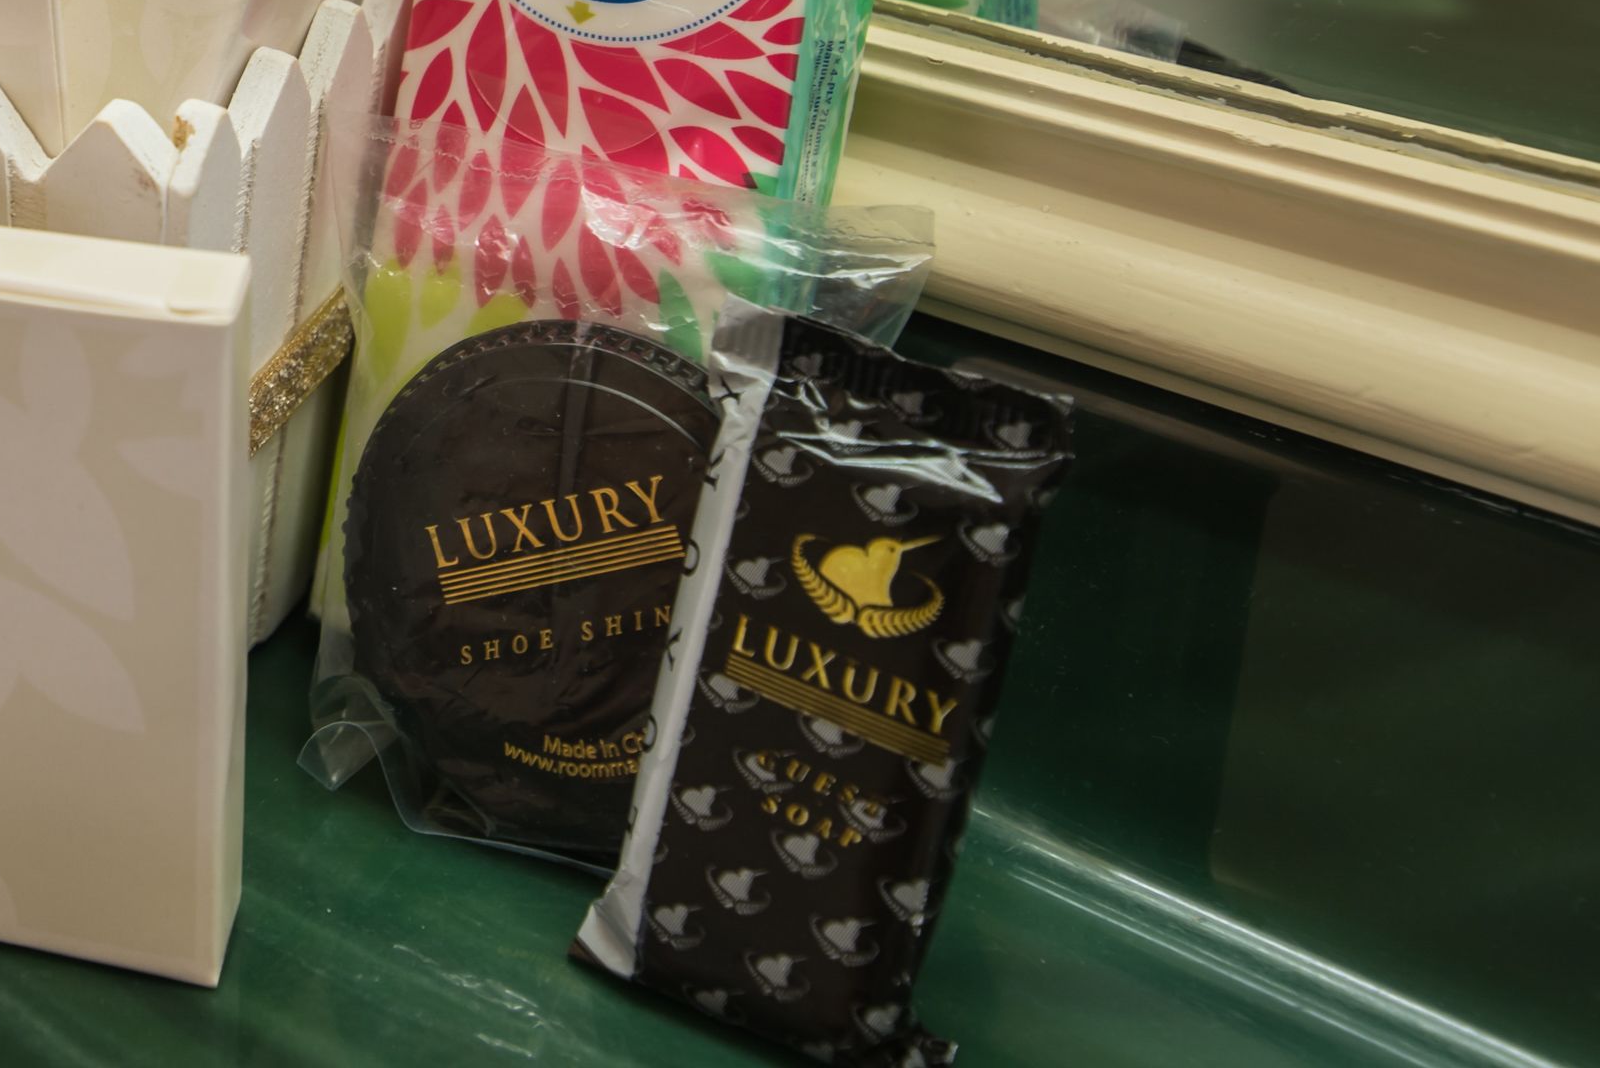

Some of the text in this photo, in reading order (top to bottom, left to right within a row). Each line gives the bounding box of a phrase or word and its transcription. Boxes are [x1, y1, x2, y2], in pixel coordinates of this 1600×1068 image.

[425, 475, 665, 569] LUXURY
[460, 605, 672, 666] SHOE SHIN
[732, 614, 958, 734] LUXURY
[504, 741, 640, 778] www.roomma
[543, 734, 597, 759] Made
[760, 794, 862, 848] SOAP
